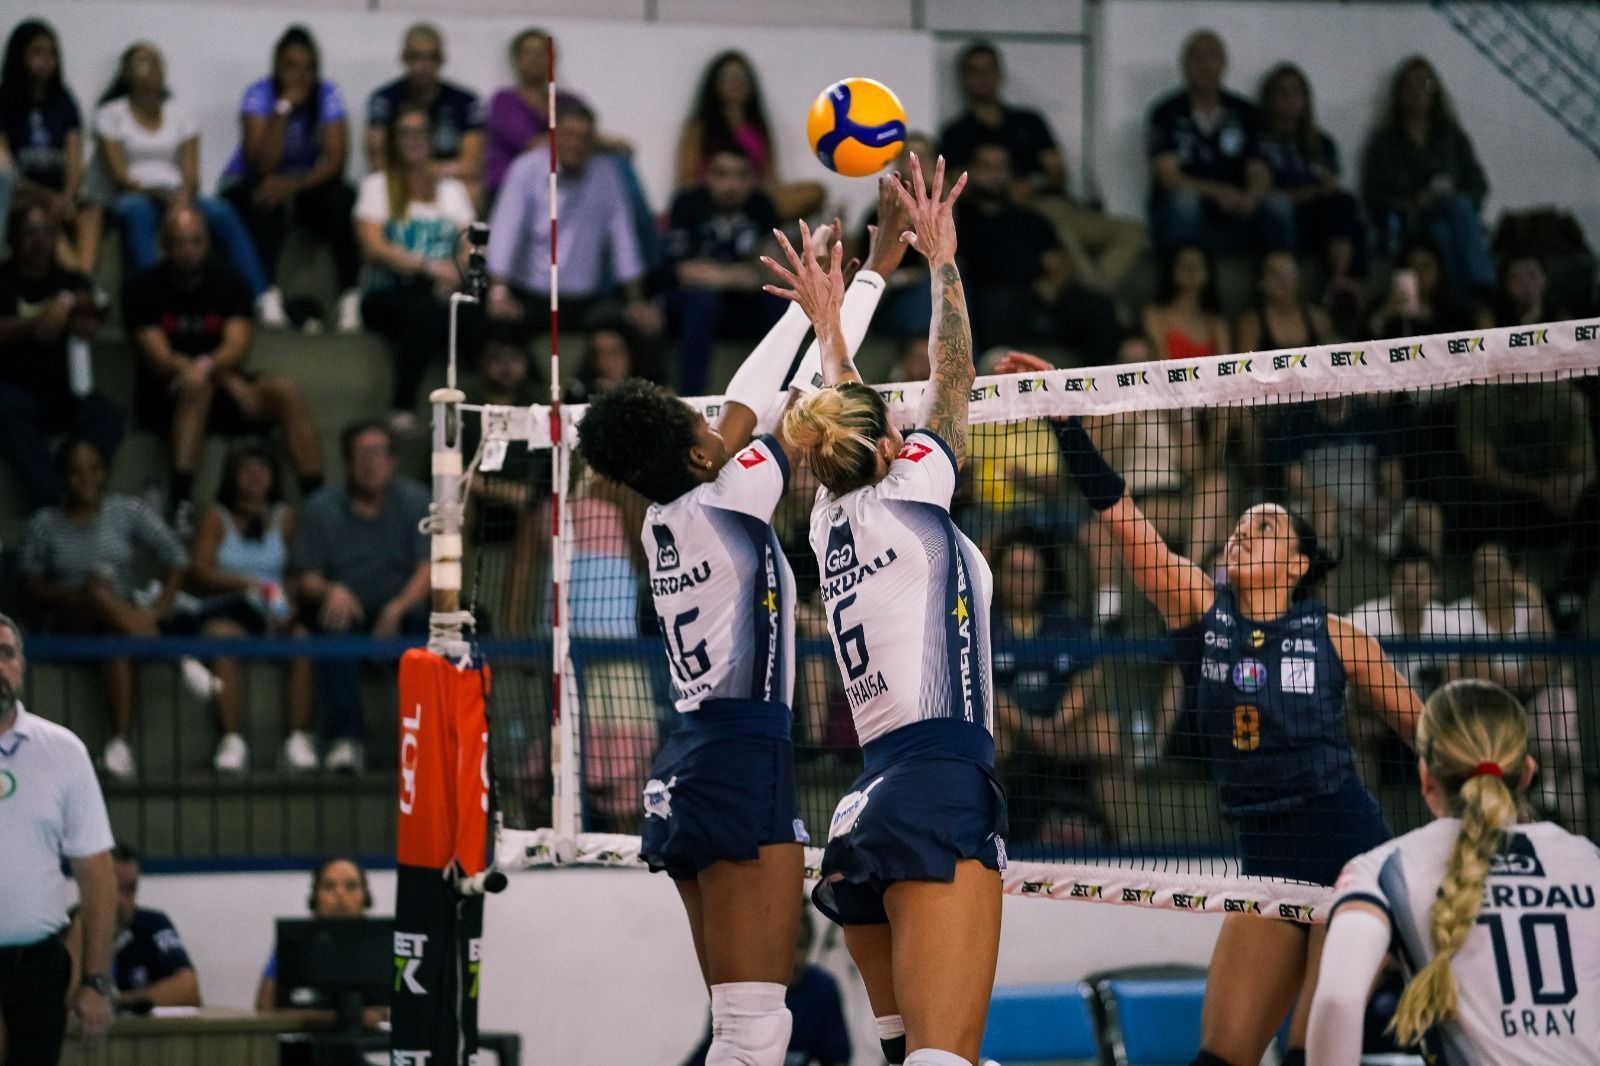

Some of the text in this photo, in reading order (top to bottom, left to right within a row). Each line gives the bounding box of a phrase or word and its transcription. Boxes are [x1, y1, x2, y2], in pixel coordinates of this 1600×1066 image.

[1508, 329, 1548, 347] BET7K
[1574, 325, 1600, 342] BET
[1389, 344, 1426, 363] BET7K
[1447, 336, 1485, 355] BET7K
[1218, 357, 1253, 376] BET7K
[1273, 354, 1307, 371] BET7K
[1331, 351, 1368, 367] BET7K
[1117, 370, 1149, 387] BET7K
[1168, 366, 1200, 384] BET7K
[652, 560, 712, 597] ERDAU
[832, 592, 870, 681] 6
[1233, 704, 1260, 750] 8
[1475, 913, 1578, 1006] 10
[1500, 1008, 1577, 1038] GRAY
